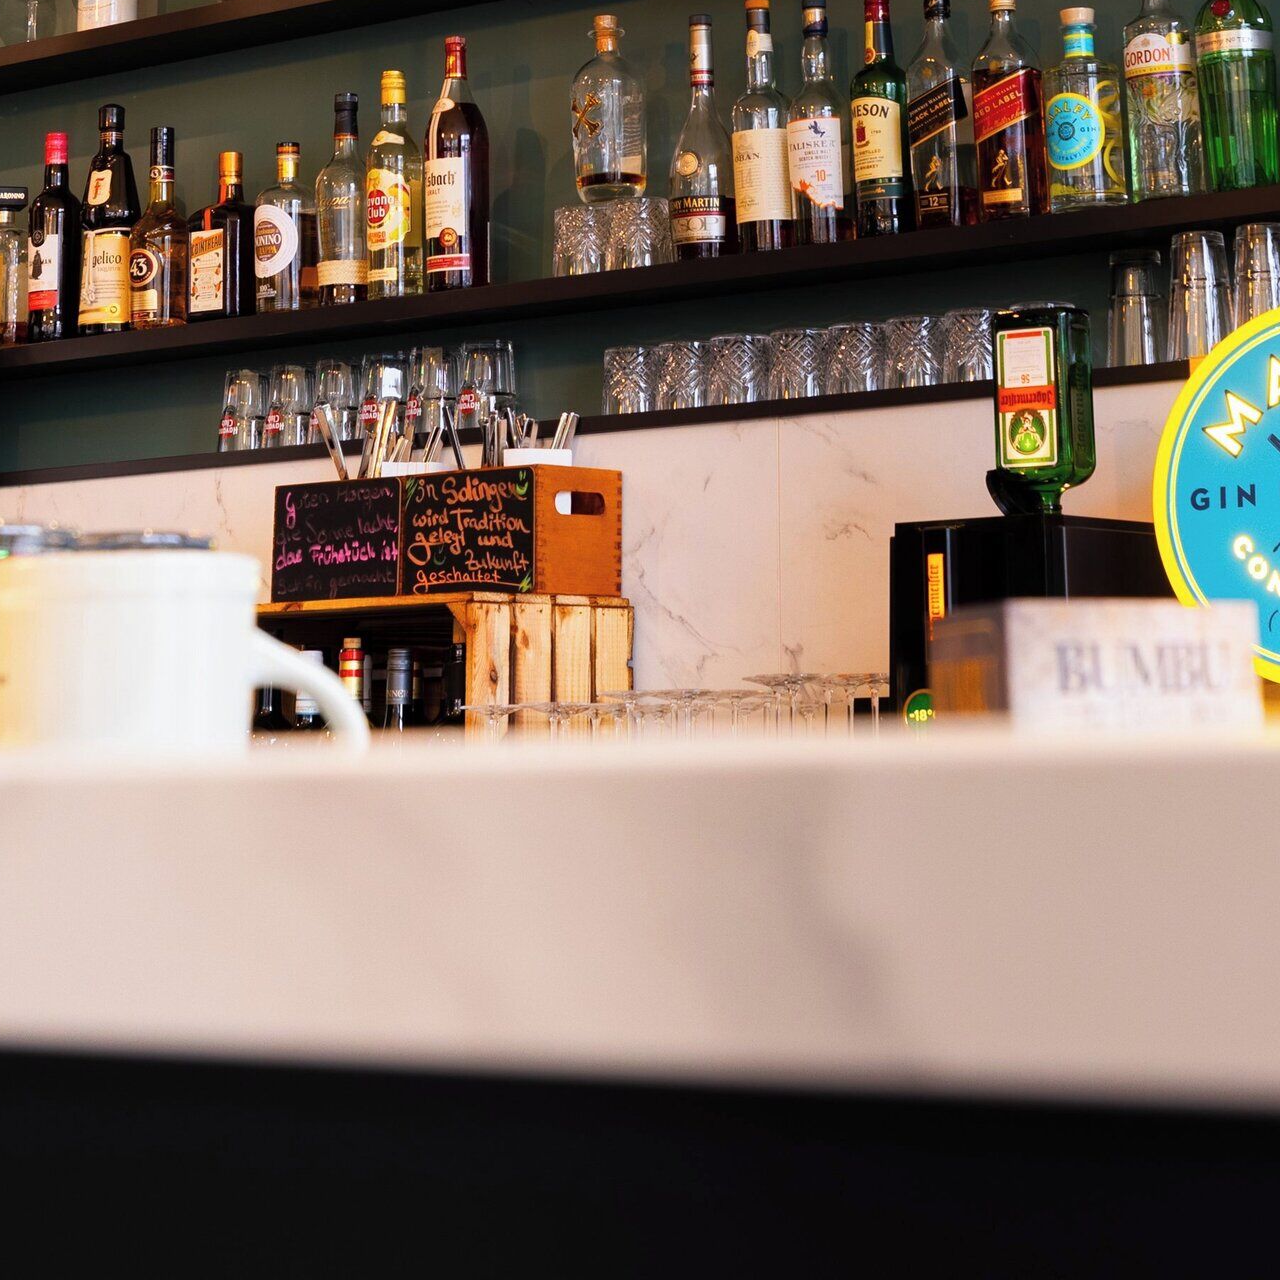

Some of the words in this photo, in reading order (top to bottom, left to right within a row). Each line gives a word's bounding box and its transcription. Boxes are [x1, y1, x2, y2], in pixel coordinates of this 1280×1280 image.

[930, 97, 955, 113] LABEL
[974, 105, 991, 120] RED
[992, 90, 1023, 109] LABEL
[1047, 100, 1094, 126] MALFY
[789, 140, 836, 153] TALISKER
[735, 152, 760, 164] OBAN
[425, 171, 455, 187] sbach
[815, 169, 827, 183] 10
[367, 194, 395, 207] avana
[683, 196, 720, 208] MARTIN
[929, 195, 940, 207] 12
[367, 205, 386, 219] Club
[256, 233, 282, 247] ONINO
[91, 250, 123, 269] gelico
[130, 257, 148, 277] 43
[1000, 390, 1053, 408] Jägermeister
[1190, 483, 1257, 511] GIN
[412, 508, 449, 527] wird
[449, 507, 531, 533] Tradition
[477, 531, 514, 549] und
[381, 539, 399, 561] ist
[464, 549, 530, 576] Zukunft
[1055, 637, 1233, 695] BUMBU
